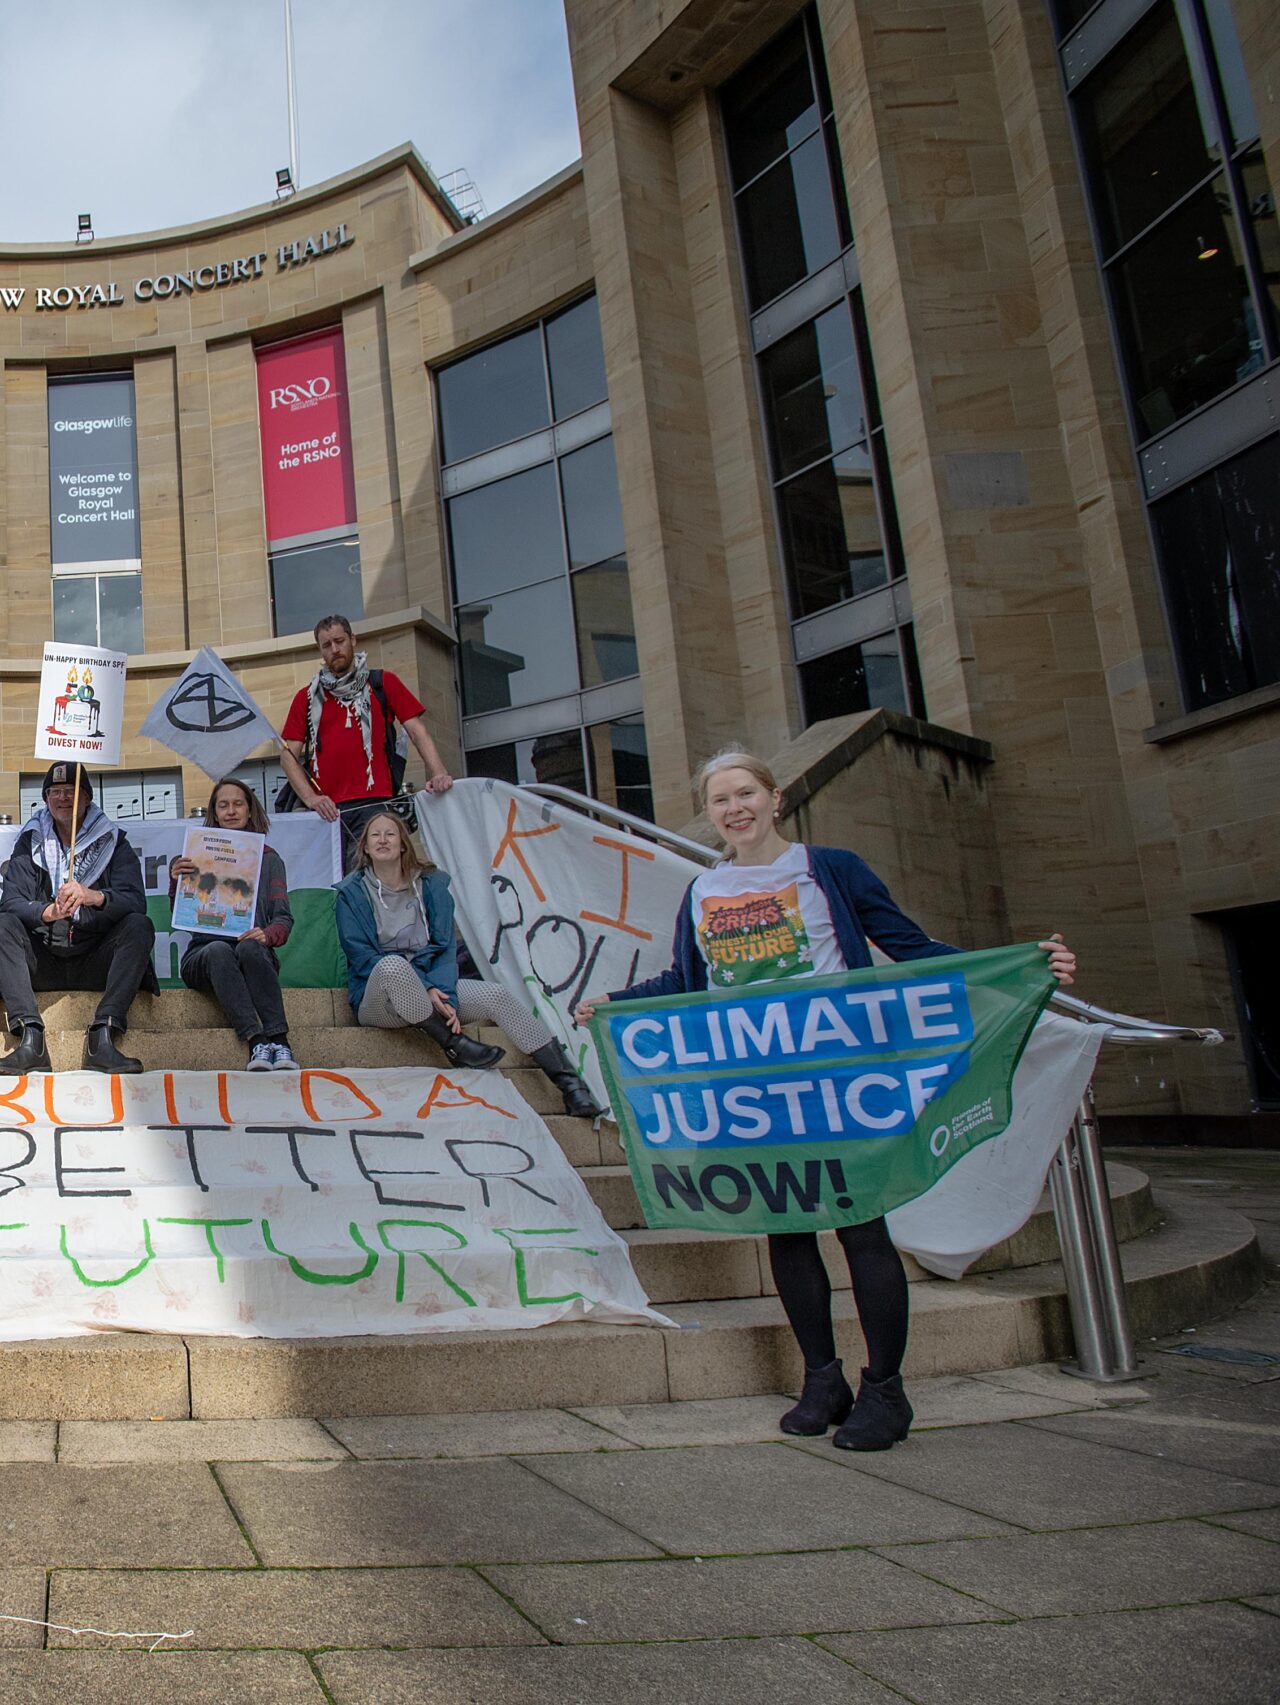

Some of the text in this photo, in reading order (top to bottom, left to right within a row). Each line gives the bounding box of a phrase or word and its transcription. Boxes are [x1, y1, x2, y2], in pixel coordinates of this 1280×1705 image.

[36, 283, 124, 313] ROYAL
[134, 252, 267, 300] CONCERT
[276, 223, 355, 269] HALL
[269, 377, 330, 409] RSNO
[281, 432, 337, 455] Home of
[278, 445, 341, 470] the RSNO
[59, 471, 132, 485] Welcome to
[68, 486, 123, 499] Glasgow
[58, 509, 135, 524] Concert Hall
[78, 498, 114, 512] Royal
[44, 655, 78, 664] UN-HAPPY
[79, 658, 111, 668] BIRTHDAY
[48, 737, 103, 751] DIVEST NOW!
[712, 906, 780, 933] CRISIS
[749, 933, 762, 942] IN
[763, 926, 790, 938] OUR
[711, 934, 797, 964] FUTURE
[622, 983, 960, 1068] CLIMATE
[417, 1073, 519, 1119] A
[652, 1158, 853, 1214] NOW!
